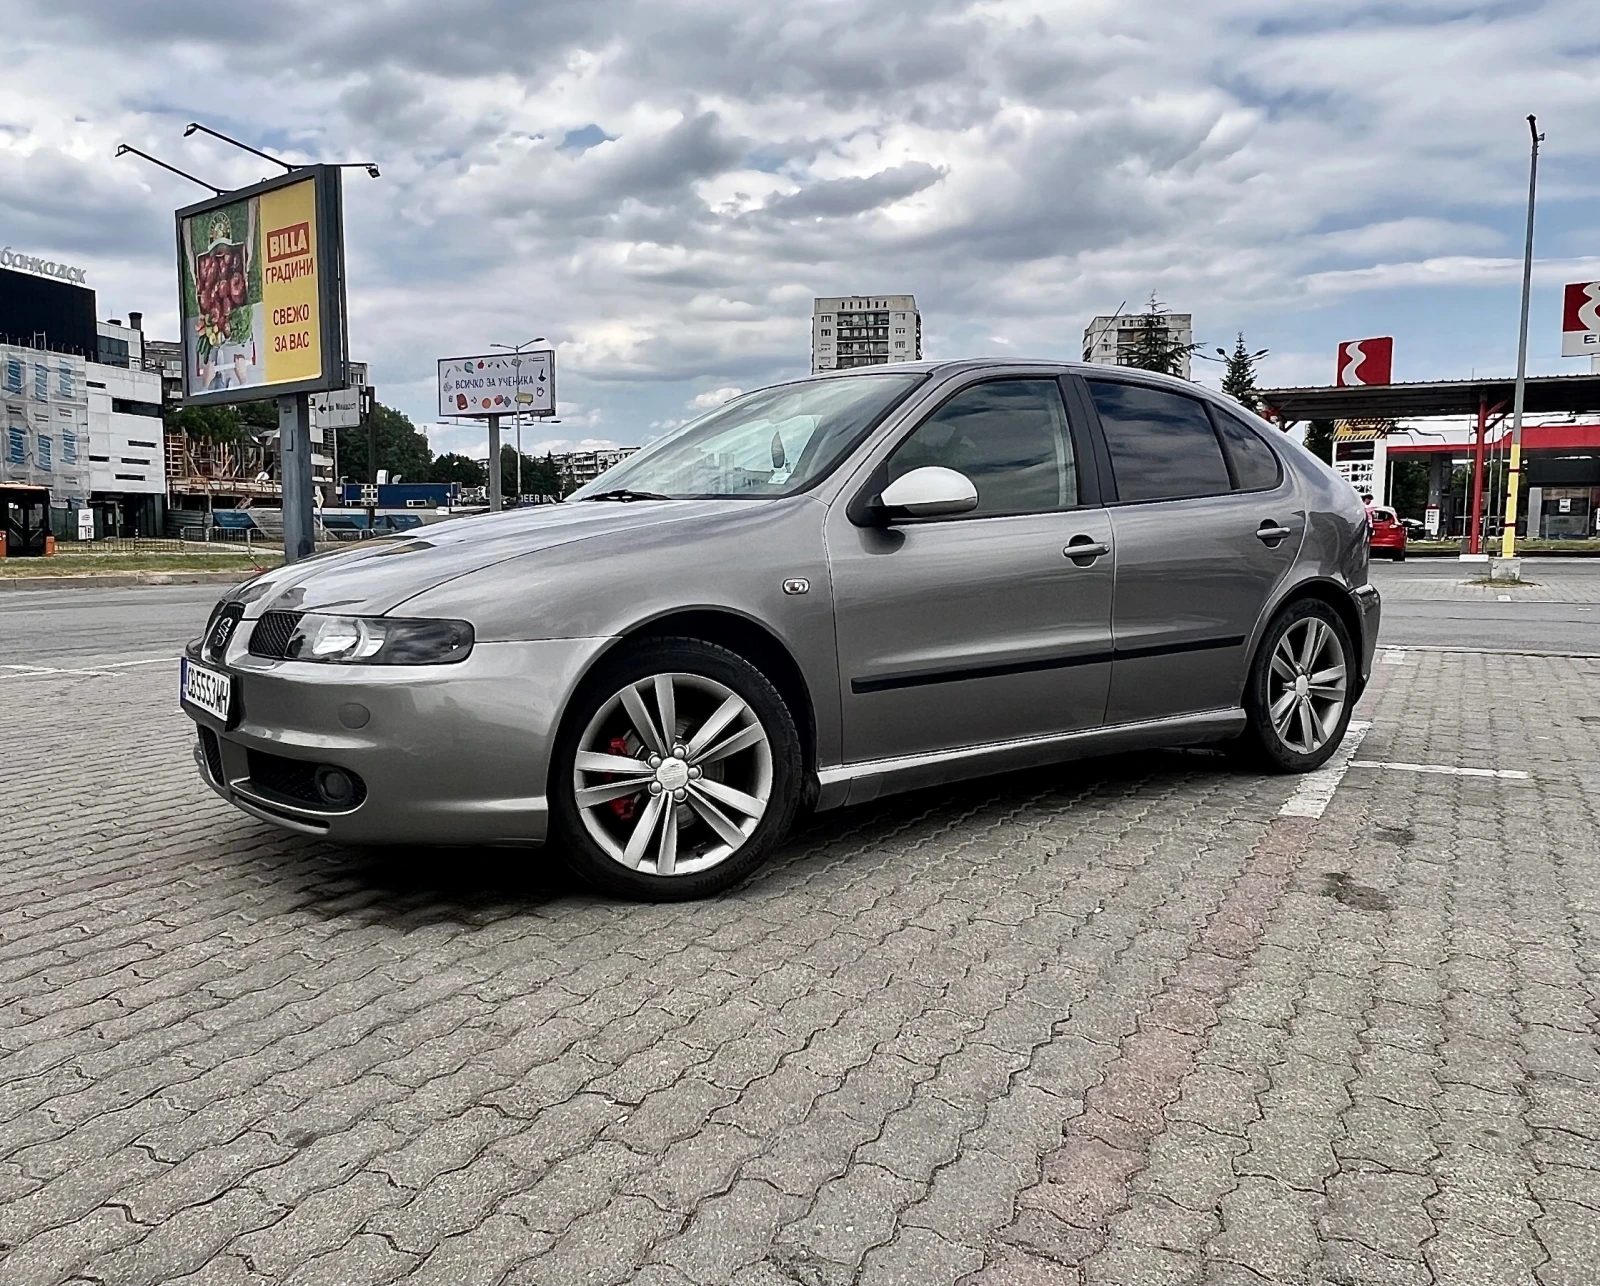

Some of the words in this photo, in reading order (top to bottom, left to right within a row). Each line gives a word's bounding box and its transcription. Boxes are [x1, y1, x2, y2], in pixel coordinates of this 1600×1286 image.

[269, 229, 308, 258] BILLA
[265, 257, 314, 284] ГРАДИНИ
[273, 304, 310, 326] СВЕЖО
[274, 335, 288, 352] ЗА
[289, 331, 310, 351] ВАС
[1584, 334, 1600, 344] E
[455, 378, 484, 390] ВСИЧКО
[486, 377, 496, 388] ЗА
[498, 375, 534, 387] УЧЕНИКА
